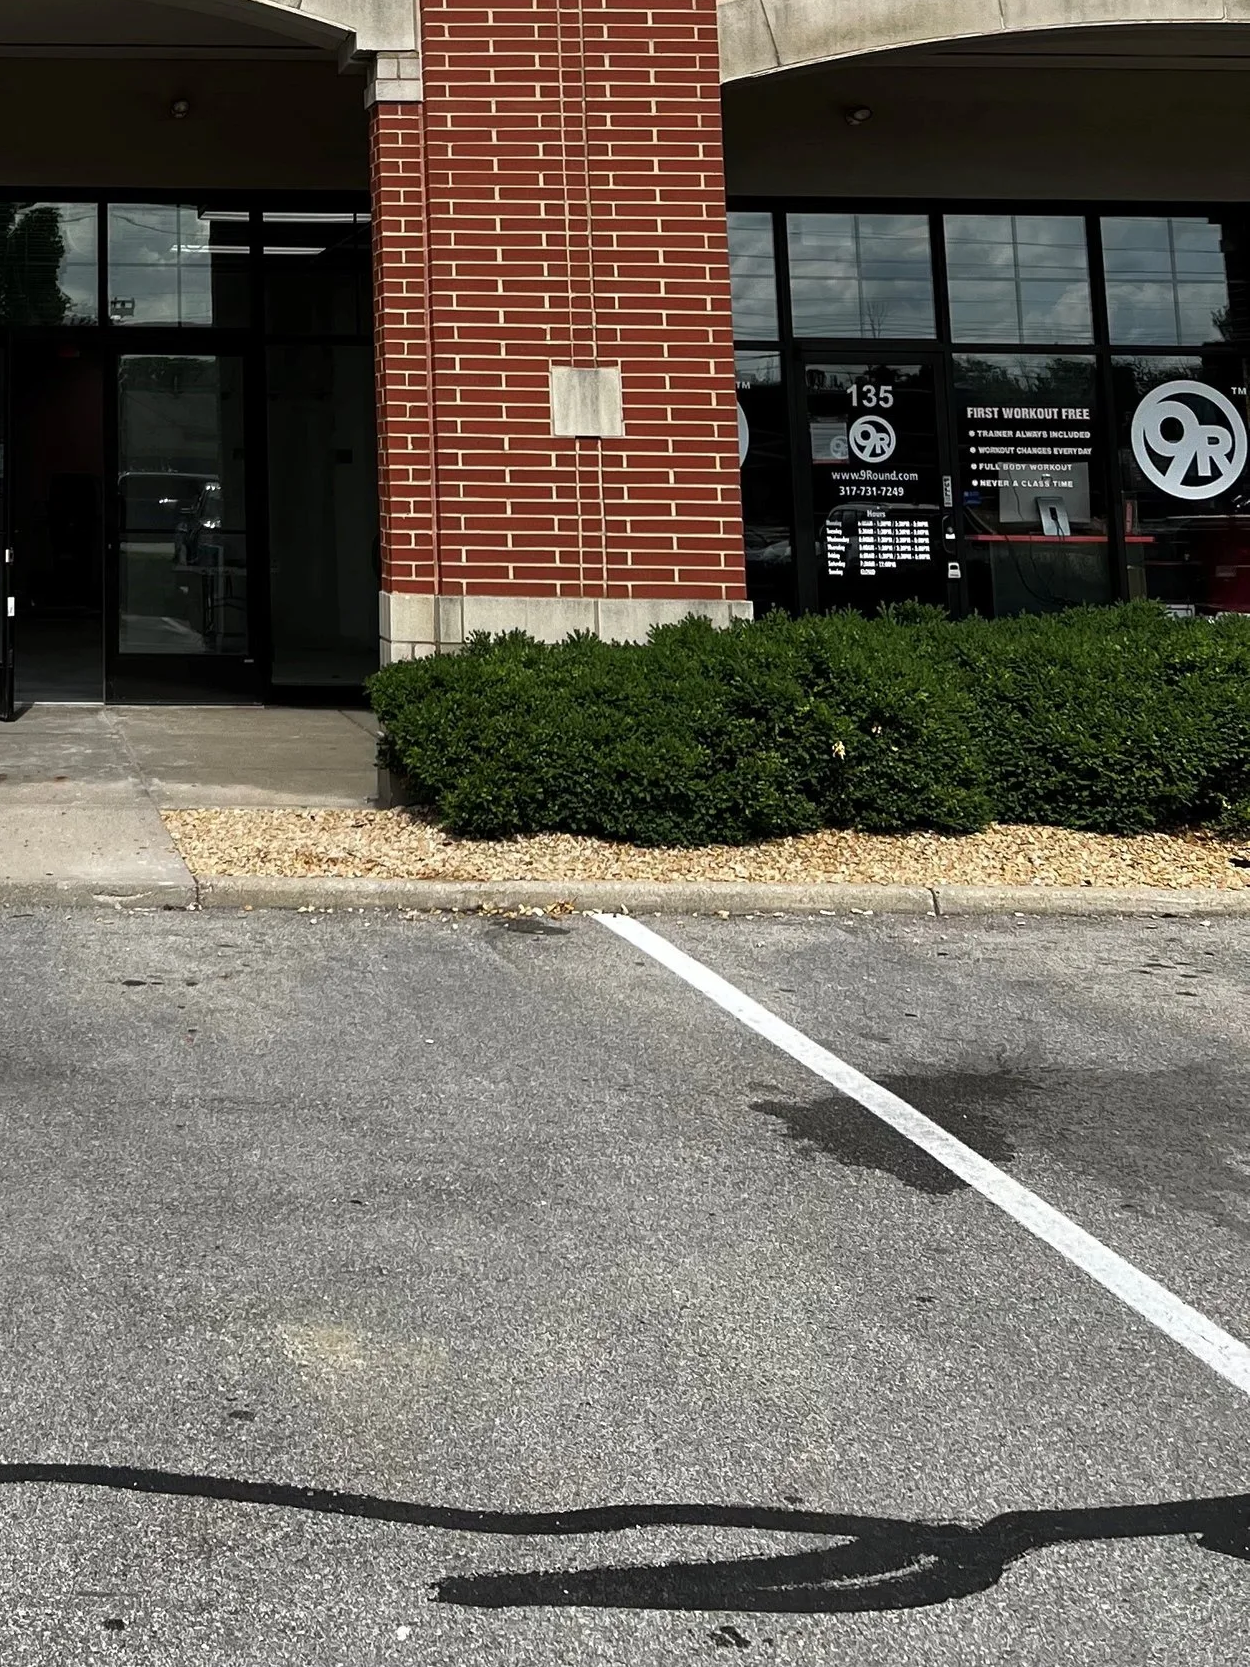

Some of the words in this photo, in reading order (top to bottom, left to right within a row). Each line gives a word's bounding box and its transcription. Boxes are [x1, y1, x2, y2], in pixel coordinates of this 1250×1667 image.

[1230, 386, 1247, 396] TM
[846, 384, 894, 408] 135
[966, 407, 999, 419] FIRST
[1001, 407, 1059, 420] WORKOUT
[1061, 408, 1091, 420] FREE
[977, 430, 1014, 438] TRAINER
[1015, 430, 1048, 439] ALWAYS
[1049, 430, 1091, 439] INCLUDED
[978, 446, 1015, 454] WORKOUT
[1016, 447, 1052, 455] CHANGES
[1053, 447, 1092, 455] EVERYDAY
[979, 463, 1000, 471] FULL
[1003, 463, 1027, 471] BODY
[1029, 464, 1073, 472] WORKOUT
[831, 469, 919, 481] www.9Round.com
[980, 479, 1010, 488] NEVER
[1021, 480, 1050, 488] CLASS
[1052, 480, 1074, 488] TIME
[839, 485, 905, 497] 317-731-7249
[866, 509, 887, 518] Hours
